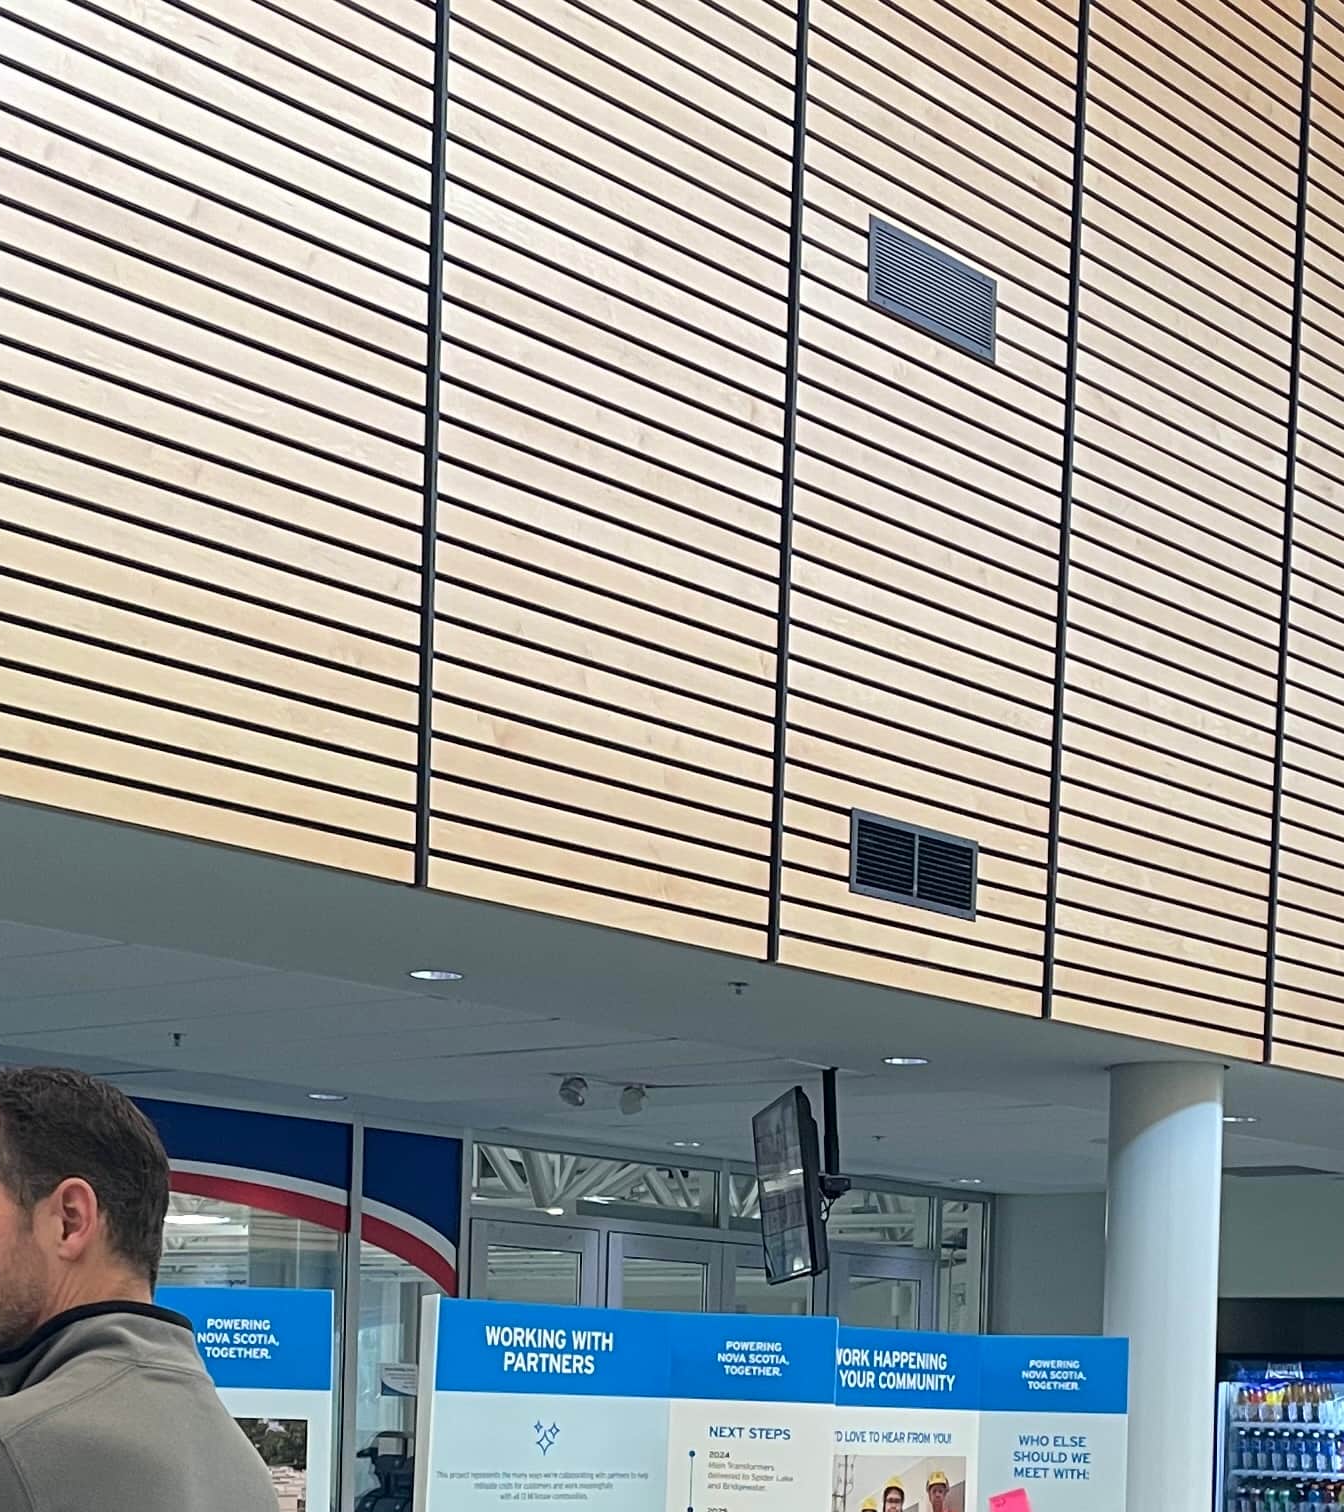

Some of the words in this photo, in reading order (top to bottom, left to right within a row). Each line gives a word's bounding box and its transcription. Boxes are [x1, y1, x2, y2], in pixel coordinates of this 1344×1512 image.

[207, 1318, 271, 1331] POWERING
[197, 1332, 228, 1345] NOVA
[233, 1333, 280, 1347] SCOTIA,
[485, 1325, 567, 1349] WORKING
[572, 1330, 614, 1352] WITH
[205, 1346, 272, 1359] TOGETHER.
[725, 1340, 783, 1352] POWERING
[503, 1351, 595, 1375] PARTNERS
[717, 1352, 747, 1363] NOVA
[748, 1353, 790, 1366] SCOTIA,
[873, 1350, 948, 1370] HAPPENING
[1029, 1359, 1080, 1369] POWERING
[723, 1365, 783, 1377] TOGETHER.
[1021, 1370, 1048, 1380] NOVA
[839, 1369, 876, 1388] YOUR
[878, 1371, 956, 1392] COMMUNITY
[709, 1426, 745, 1438] NEXT
[749, 1427, 791, 1440] STEPS
[844, 1431, 866, 1443] LOVE
[869, 1431, 880, 1443] TO
[882, 1431, 906, 1443] HEAR
[907, 1432, 931, 1444] FROM
[1018, 1434, 1050, 1447] WHO
[1053, 1435, 1088, 1448] ELSE
[1013, 1450, 1068, 1464] SHOULD
[1071, 1452, 1092, 1464] WE
[1013, 1466, 1050, 1479] MEET
[1053, 1467, 1091, 1481] WITH:
